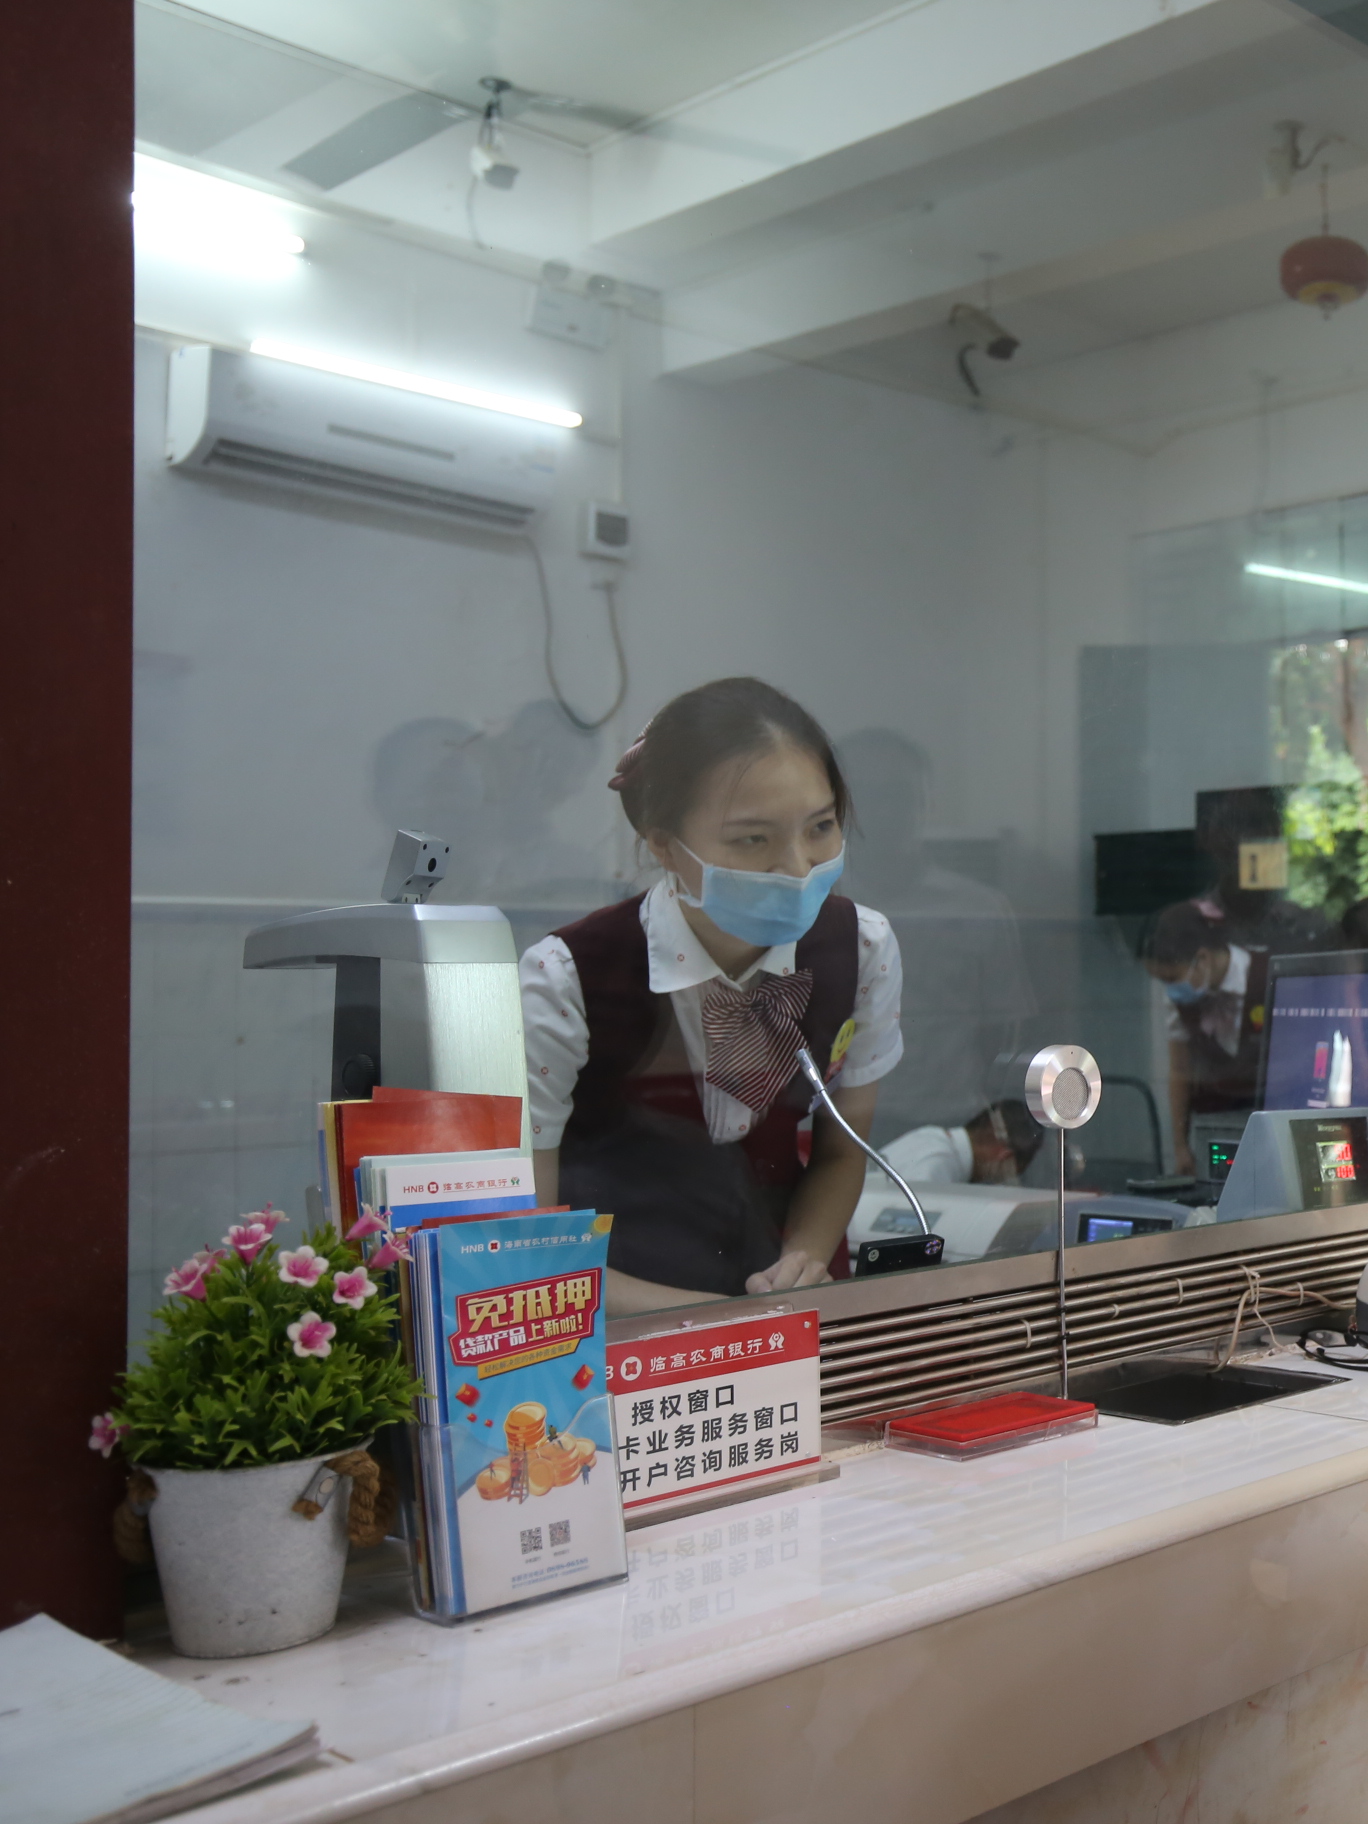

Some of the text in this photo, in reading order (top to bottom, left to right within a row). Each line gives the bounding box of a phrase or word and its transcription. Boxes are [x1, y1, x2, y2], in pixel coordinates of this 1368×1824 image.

[403, 1185, 424, 1194] HNB
[461, 1243, 484, 1254] HNB
[465, 1276, 592, 1333] 免抵押
[650, 1338, 763, 1373] 临高农商银行
[631, 1384, 735, 1426] 授权窗口
[619, 1402, 799, 1460] 卡业务服务窗口
[620, 1431, 799, 1493] 开户咨询服务岗
